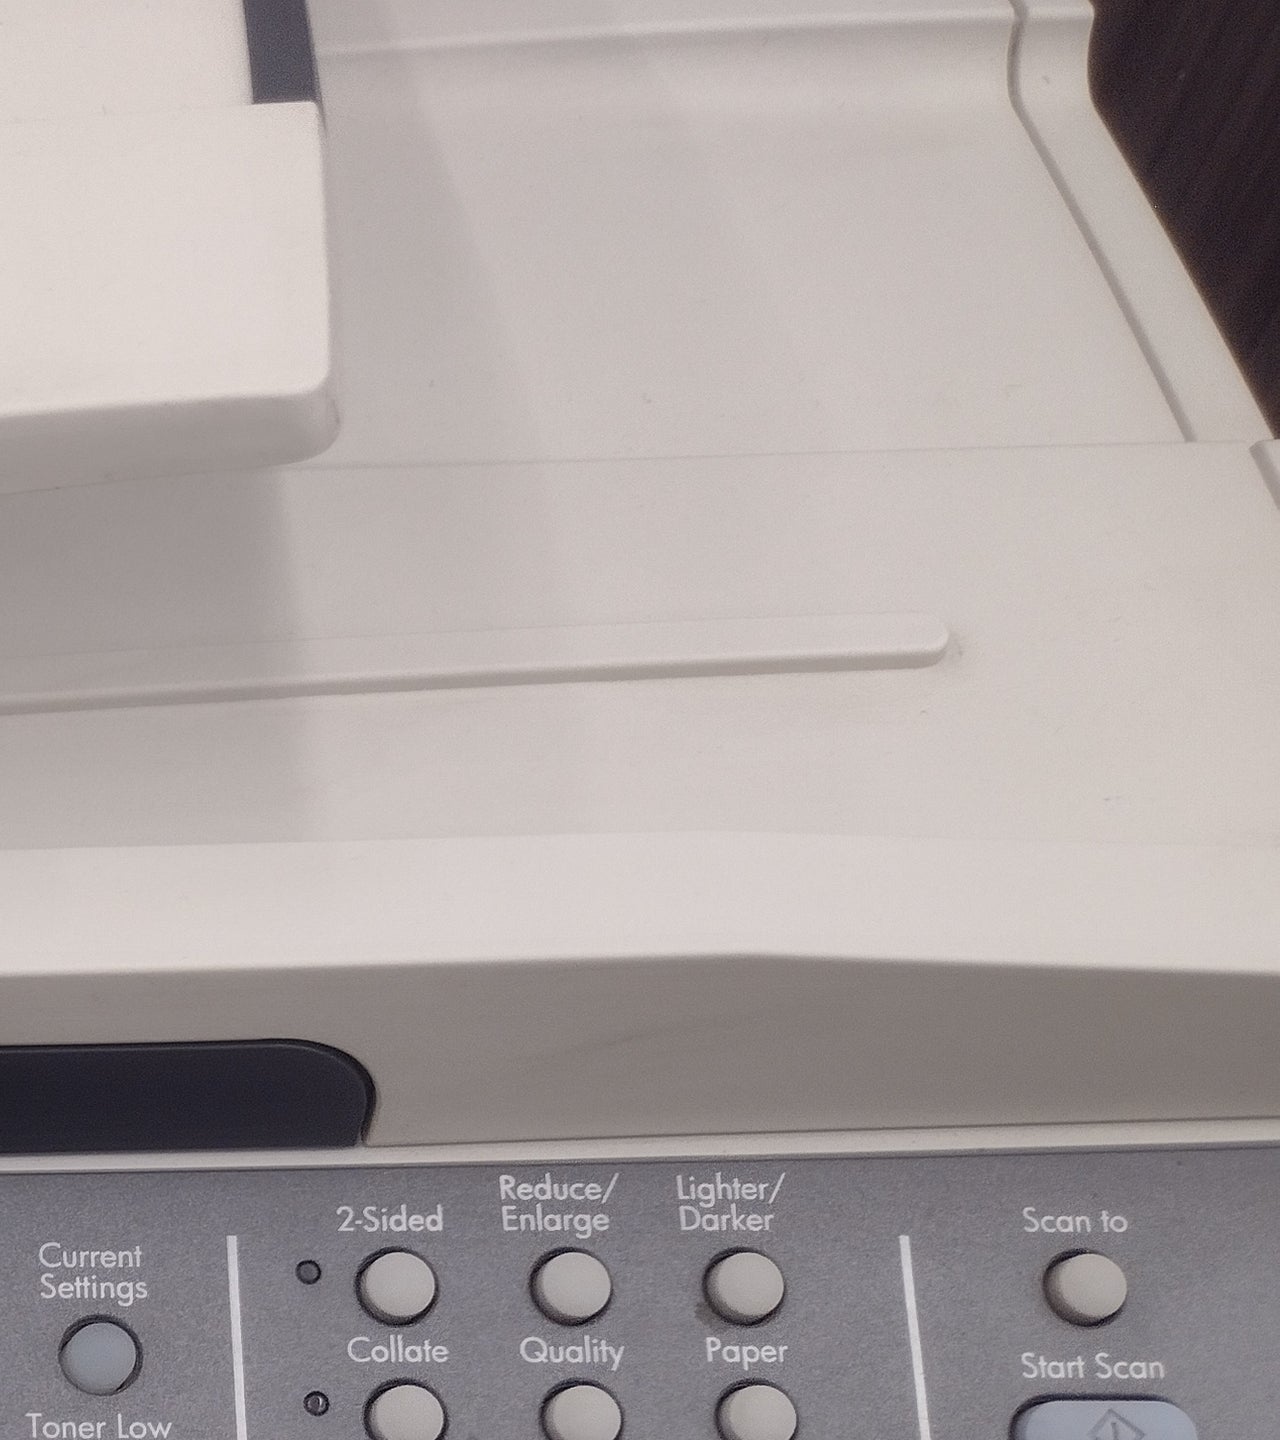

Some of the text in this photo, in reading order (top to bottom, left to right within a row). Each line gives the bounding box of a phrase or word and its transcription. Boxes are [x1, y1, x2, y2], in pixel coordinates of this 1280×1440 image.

[499, 1172, 619, 1204] Reduce/
[675, 1171, 786, 1206] Lighter/
[336, 1204, 444, 1233] 2-Sided
[501, 1205, 610, 1240] Enlarge
[679, 1205, 775, 1232] Darker
[1022, 1206, 1128, 1233] Scan to
[38, 1241, 143, 1269] Current
[40, 1272, 148, 1307] Settings
[347, 1334, 449, 1363] Collate
[519, 1334, 625, 1371] Quality
[705, 1336, 789, 1371] Paper
[1021, 1351, 1165, 1380] Start Scan
[25, 1412, 173, 1440] Toner Low
